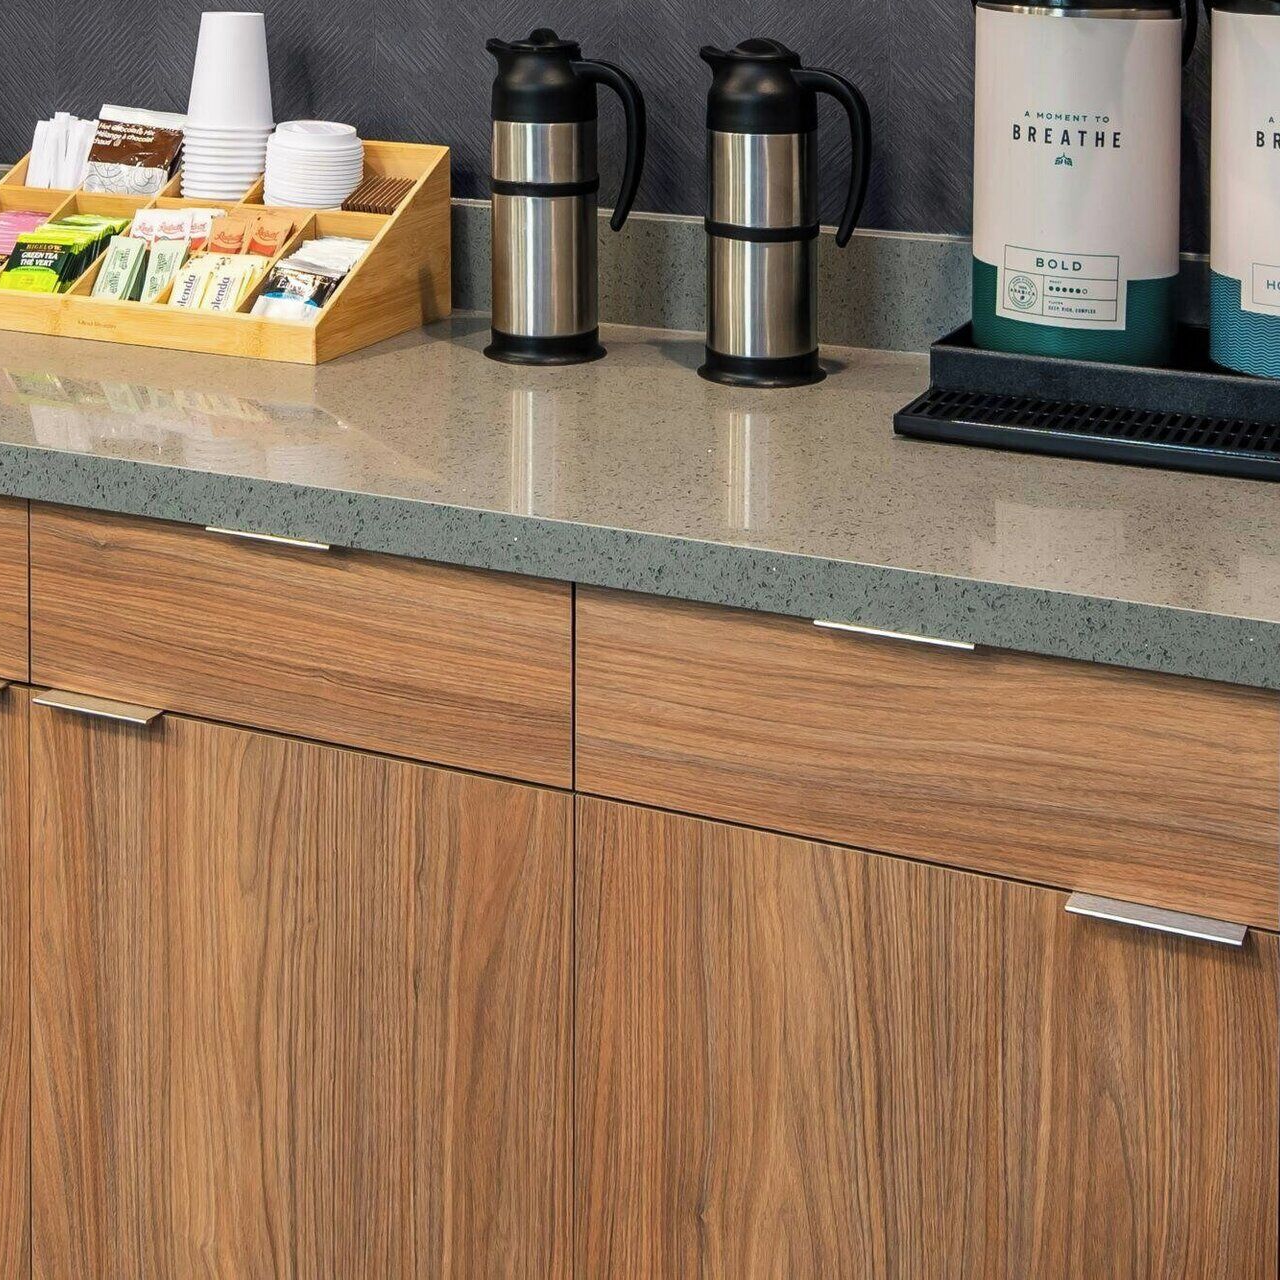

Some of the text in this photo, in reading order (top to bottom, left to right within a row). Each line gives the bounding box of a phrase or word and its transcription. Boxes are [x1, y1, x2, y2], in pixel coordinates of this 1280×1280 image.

[1037, 112, 1087, 122] MOMENT
[1095, 115, 1110, 123] TO
[1013, 124, 1121, 148] BREATHE
[21, 251, 44, 259] GREEN
[1036, 257, 1082, 271] BOLD
